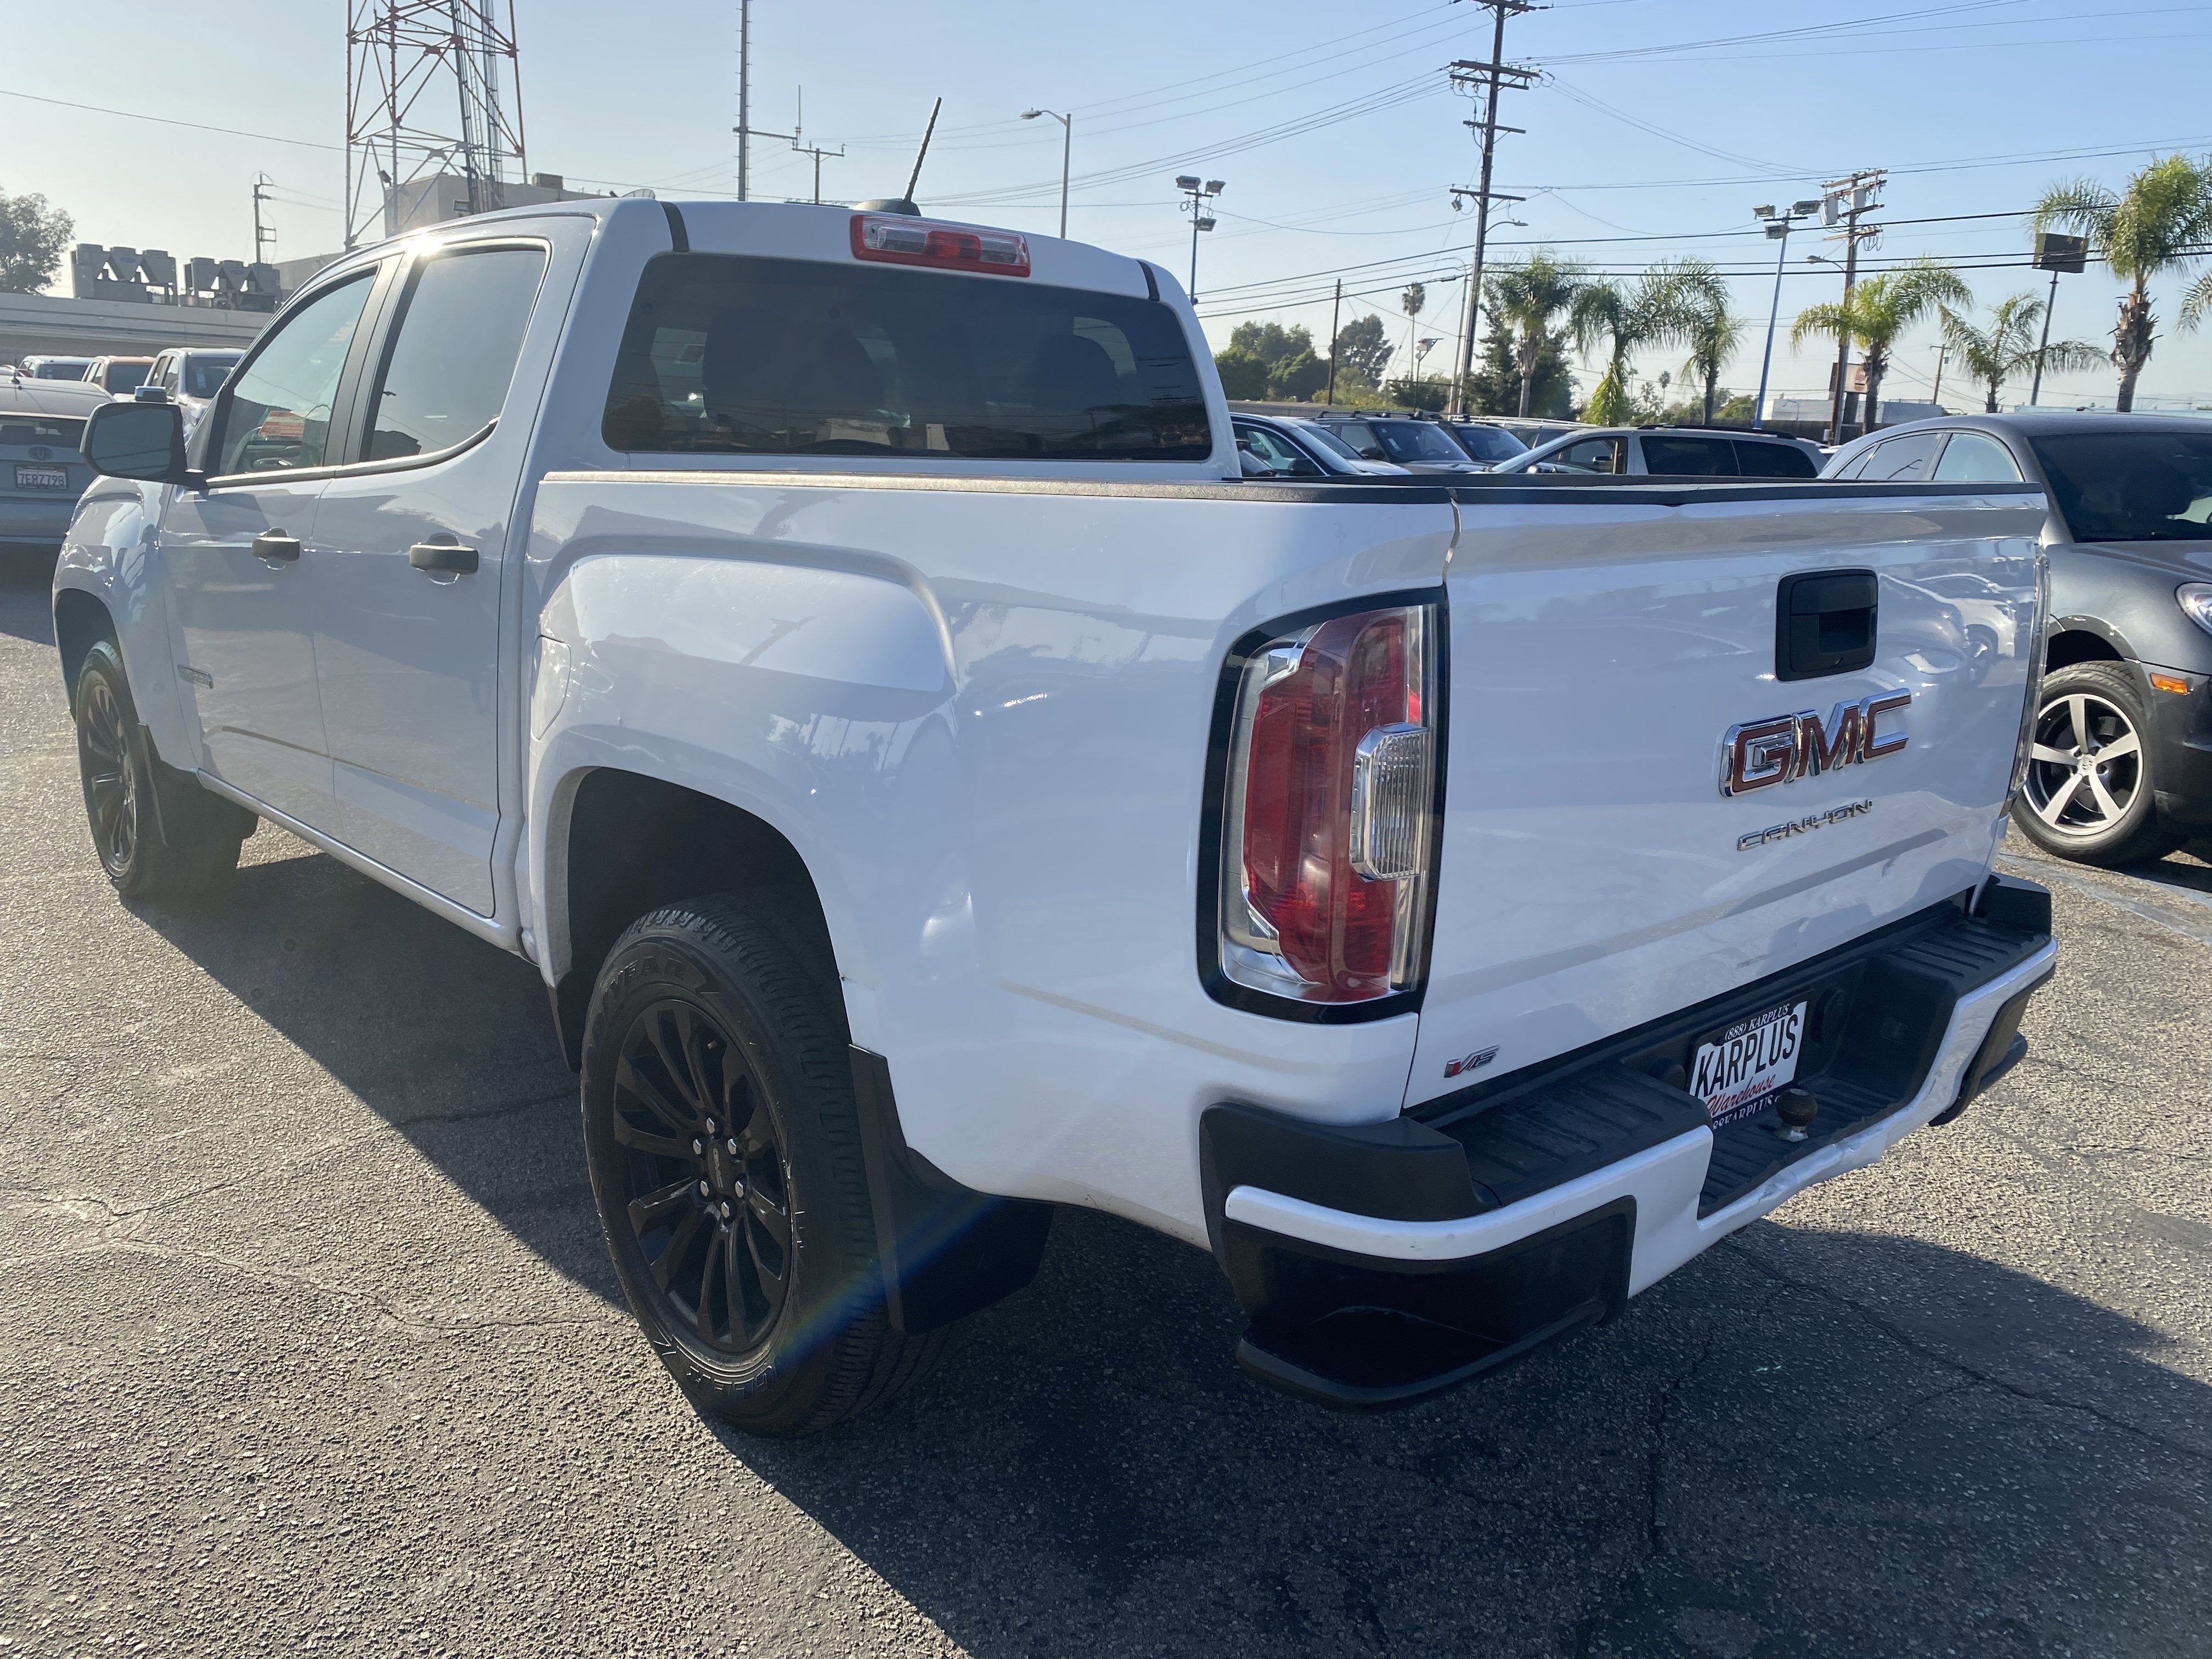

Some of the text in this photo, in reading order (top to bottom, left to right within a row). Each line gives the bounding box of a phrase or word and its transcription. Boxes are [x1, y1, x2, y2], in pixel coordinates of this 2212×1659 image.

[1719, 687, 1911, 797] GMC
[1737, 799, 1873, 851] CANYON
[1725, 1003, 1790, 1041] (888) KARPLUS
[1444, 1044, 1500, 1078] V6
[1695, 1014, 1798, 1098] KARPLUS
[1707, 1074, 1777, 1116] Warehouse
[712, 1147, 725, 1189] GMC
